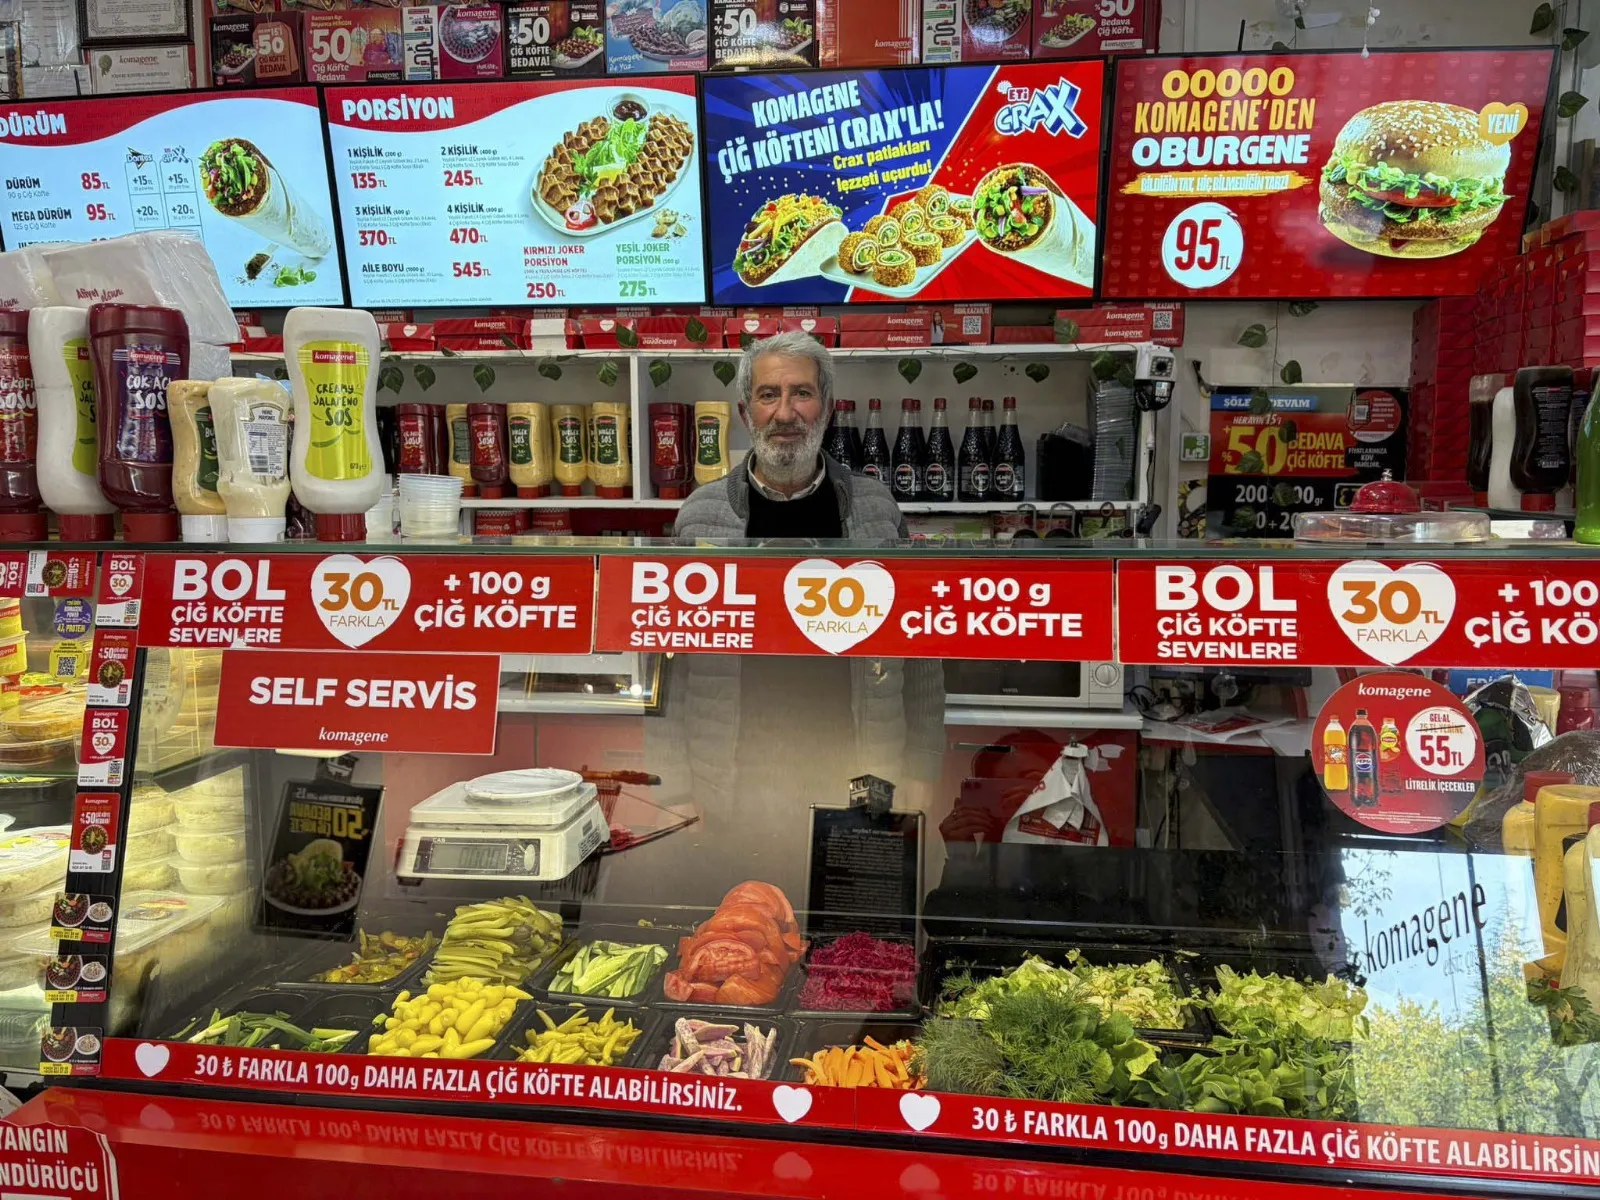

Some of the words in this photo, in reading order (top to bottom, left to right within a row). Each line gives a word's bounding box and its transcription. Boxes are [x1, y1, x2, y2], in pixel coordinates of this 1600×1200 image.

[457, 9, 496, 18] komagene
[723, 8, 757, 36] 50
[213, 23, 249, 32] komagene
[519, 16, 550, 45] 50
[1097, 27, 1110, 36] Çiğ
[1112, 26, 1134, 34] Köfte
[259, 34, 284, 55] 50
[312, 28, 351, 62] 50
[731, 35, 756, 46] KÖFTE
[875, 39, 913, 48] komagene
[510, 45, 524, 56] ÇİĞ
[525, 44, 550, 55] KÖFTE
[119, 55, 158, 64] komagene
[260, 63, 286, 73] BEDAVA
[312, 65, 326, 73] Çiğ
[327, 63, 349, 71] Köfte
[511, 56, 550, 68] BEDAVA!
[670, 59, 704, 67] komagene
[1162, 67, 1294, 99] OOOOO
[343, 95, 455, 122] PORSİYON
[752, 80, 861, 128] KOMAGENE
[994, 77, 1088, 139] CRAX
[0, 111, 67, 137] DÜRÜM
[1135, 98, 1315, 133] KOMAGENE'DEN
[1487, 110, 1520, 135] YENİ
[441, 147, 446, 155] 2
[448, 144, 478, 156] KİŞİLİK
[718, 143, 752, 185] ÇİĞ
[755, 119, 838, 171] KÖFTENİ
[841, 100, 945, 152] CRAX'LA!
[1132, 134, 1309, 166] OBURGENE
[347, 149, 352, 157] 1
[353, 146, 383, 158] KİŞİLİK
[833, 153, 864, 170] Crax
[867, 139, 931, 168] patlakları
[6, 176, 40, 190] DÜRÜM
[81, 172, 110, 190] 85TL
[351, 172, 387, 189] 135TL
[444, 170, 483, 186] 245TL
[837, 173, 879, 193] lezzeti
[882, 160, 932, 186] uçurdu!
[12, 211, 35, 221] MEGA
[38, 207, 72, 220] DÜRÜM
[87, 204, 116, 221] 95TL
[355, 207, 360, 215] 3
[362, 204, 391, 216] KİŞİLİK
[447, 205, 452, 213] 4
[455, 202, 484, 214] KİŞİLİK
[359, 230, 396, 246] 370TL
[450, 227, 488, 244] 470TL
[523, 246, 555, 255] KIRMIZI
[557, 245, 585, 254] JOKER
[616, 243, 639, 254] YEŞİL
[642, 243, 670, 252] JOKER
[362, 262, 379, 272] AİLE
[382, 264, 404, 272] BOYU
[524, 257, 568, 267] PORSİYON
[616, 254, 661, 264] PORSİYON
[453, 262, 491, 277] 545TL
[526, 282, 566, 298] 250TL
[619, 280, 657, 297] 275TL
[888, 316, 924, 326] komagene
[1106, 311, 1144, 320] komagene
[474, 320, 506, 330] komagene
[1105, 329, 1143, 338] komagene
[888, 334, 923, 343] komagene
[315, 351, 354, 361] komagene
[316, 383, 354, 394] CREAMY
[135, 390, 166, 410] SOS
[325, 407, 353, 426] SOS
[1222, 452, 1232, 462] %
[1289, 433, 1344, 450] BEDAVA
[1225, 426, 1287, 475] 50
[1287, 452, 1306, 472] ÇİĞ
[1308, 452, 1345, 468] KÖFTE
[1235, 485, 1267, 503] 200
[110, 560, 136, 570] BOL
[8, 561, 19, 589] BOL
[172, 559, 286, 600] BOL
[631, 562, 756, 605] BOL
[444, 575, 461, 592] +
[469, 572, 526, 595] 100
[531, 575, 550, 599] g
[931, 580, 951, 598] +
[960, 577, 1021, 601] 100
[1029, 580, 1051, 608] g
[1155, 565, 1297, 612] BOL
[1498, 583, 1519, 602] +
[1529, 580, 1599, 607] 100
[171, 602, 207, 626] ÇİĞ
[212, 602, 284, 623] KÖFTE
[329, 615, 386, 628] FARKLA
[414, 599, 465, 631] ÇİĞ
[474, 598, 576, 629] KÖFTE
[630, 608, 671, 630] ÇİĞ
[675, 607, 755, 628] KÖFTE
[900, 605, 958, 638] ÇİĞ
[967, 606, 1083, 638] KÖFTE
[806, 620, 869, 634] FARKLA
[1158, 613, 1201, 638] ÇİĞ
[1209, 613, 1297, 636] KÖFTE
[1465, 613, 1531, 646] ÇİĞ
[169, 628, 281, 643] SEVENLERE
[629, 632, 753, 649] SEVENLERE
[1357, 629, 1429, 643] FARKLA
[1157, 641, 1297, 660] SEVENLERE
[249, 677, 336, 706] SELF
[346, 674, 476, 711] SERVİS
[1358, 683, 1432, 700] komagene
[92, 718, 119, 728] BOL
[318, 727, 389, 747] komagene
[1420, 735, 1464, 766] 55TL
[1405, 778, 1437, 791] LİTRELİK
[1437, 779, 1475, 793] İÇECEKLER
[85, 812, 96, 824] 50
[1364, 883, 1487, 973] komagene
[194, 1053, 217, 1076] 30
[238, 1057, 309, 1085] FARKLA
[363, 1066, 418, 1090] DAHA
[422, 1067, 481, 1093] FAZLA
[486, 1069, 517, 1099] ÇİĞ
[523, 1068, 585, 1098] KÖFTE
[589, 1075, 743, 1112] ALABİLİRSİNİZ.
[0, 1126, 68, 1154] YANGIN
[971, 1107, 999, 1131] 30
[1024, 1111, 1108, 1141] FARKLA
[1174, 1122, 1238, 1151] DAHA
[1245, 1126, 1316, 1157] FAZLA
[1321, 1128, 1360, 1165] ÇİĞ
[1367, 1132, 1441, 1165] KÖFTE
